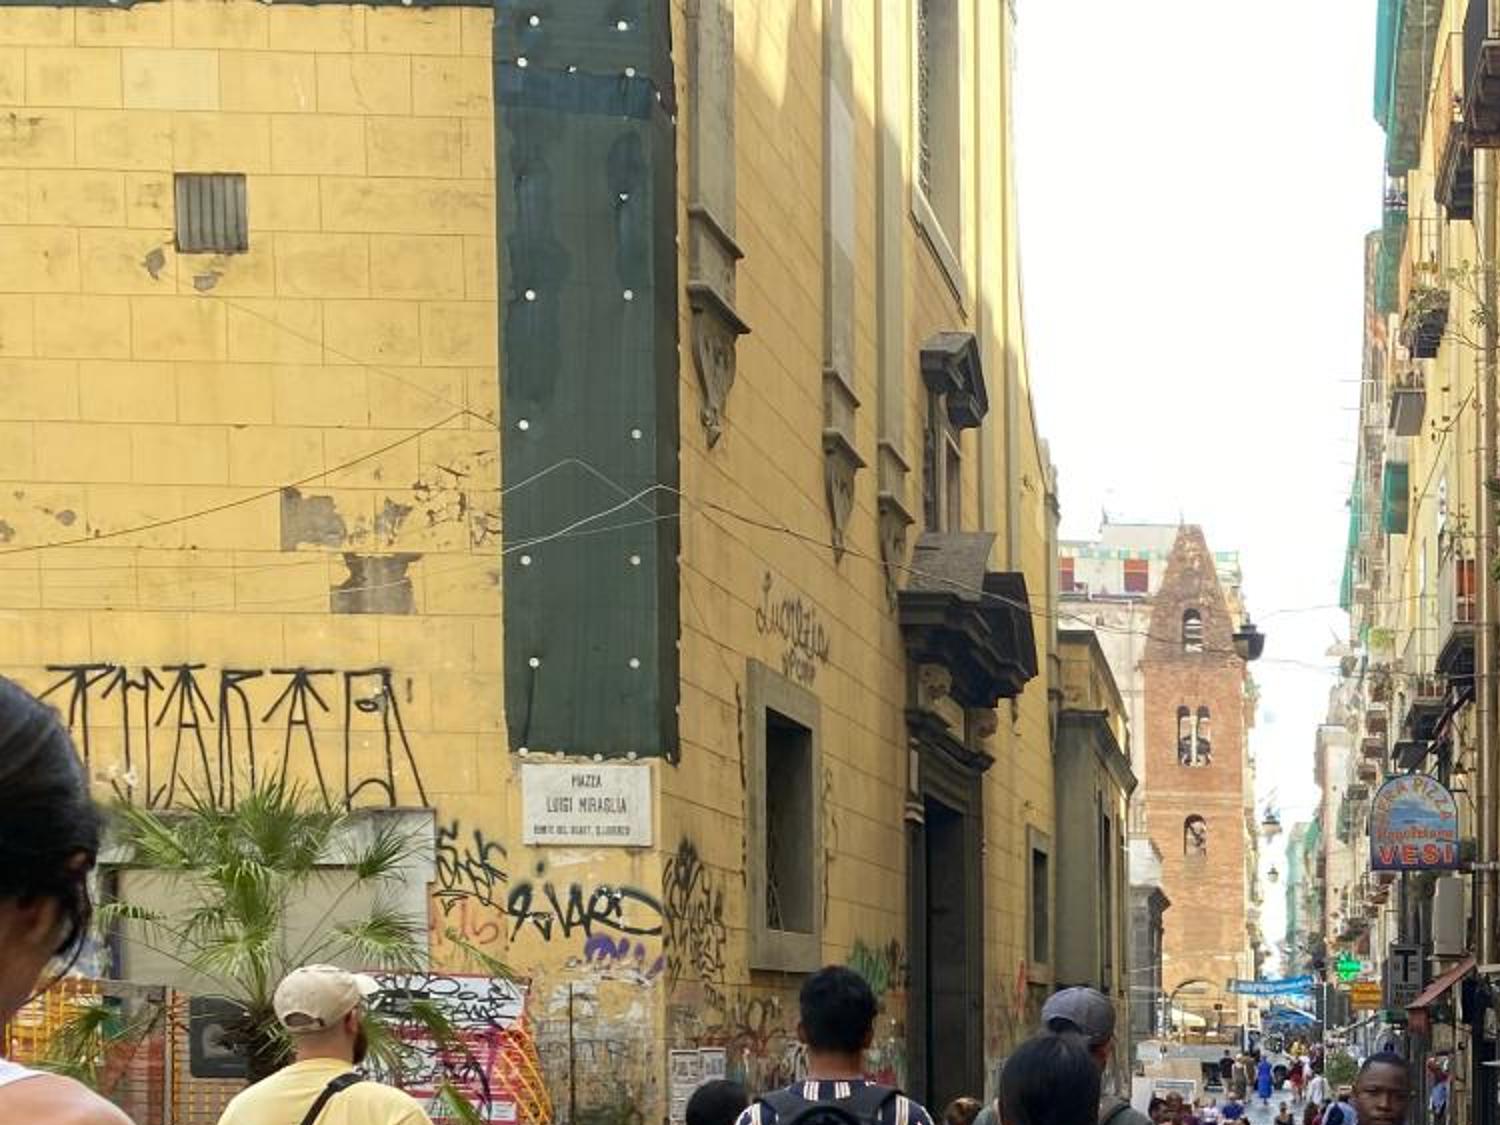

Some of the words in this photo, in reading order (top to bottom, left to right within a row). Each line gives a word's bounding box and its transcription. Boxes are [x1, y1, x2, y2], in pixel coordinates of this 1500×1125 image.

[571, 774, 602, 788] PIAZZA
[546, 797, 573, 813] LUIGI
[578, 797, 627, 813] MIRAGLIA
[1379, 843, 1454, 865] VESI
